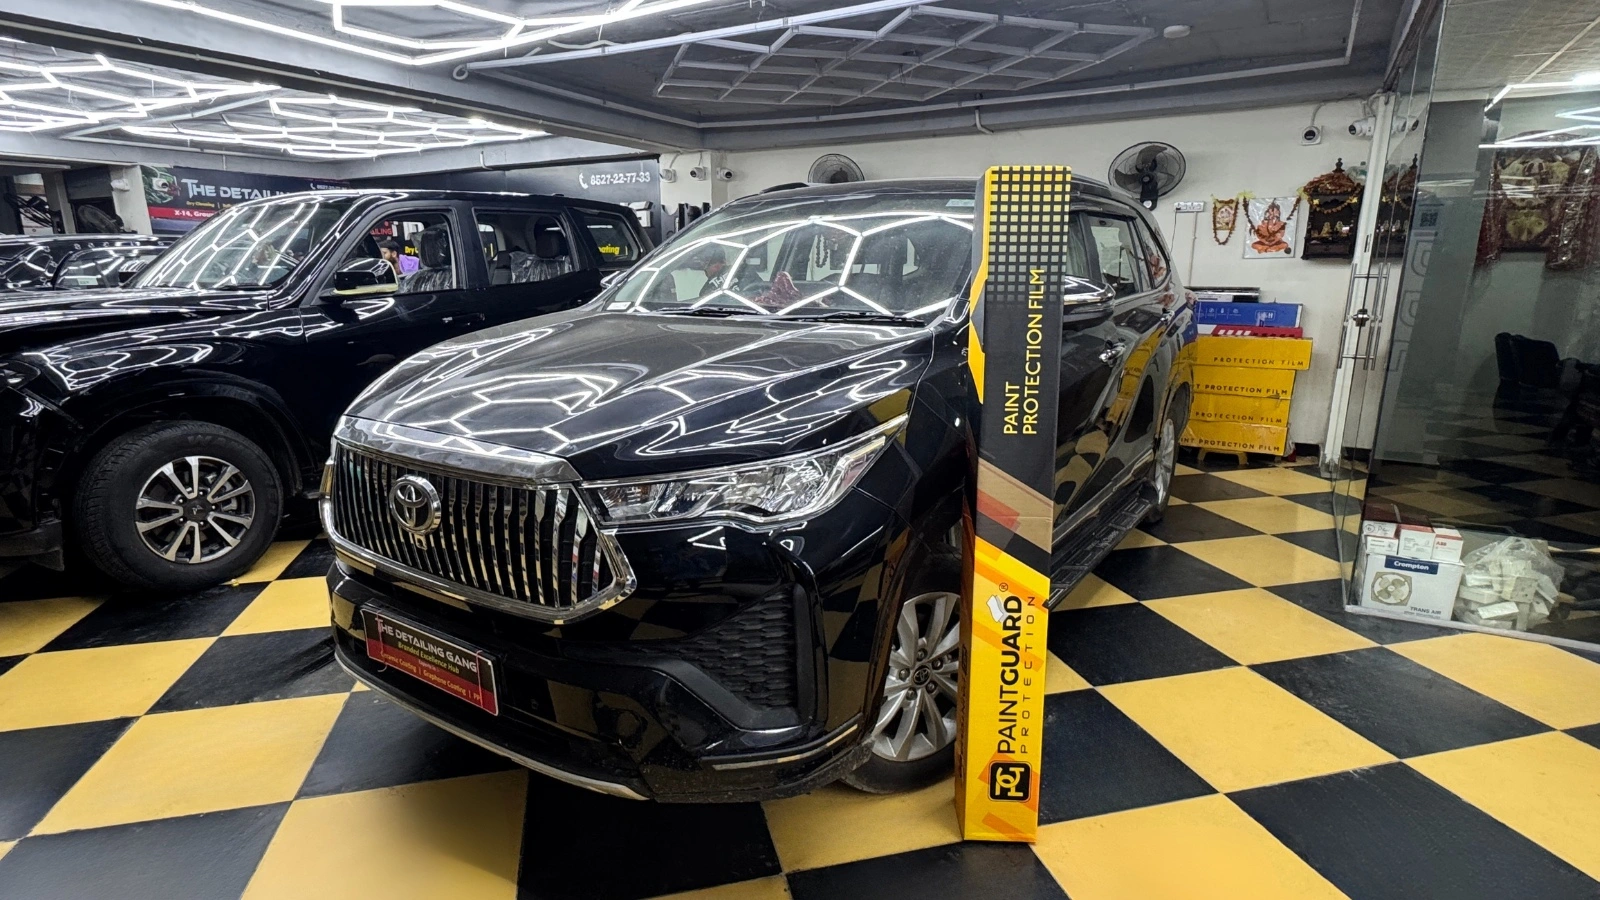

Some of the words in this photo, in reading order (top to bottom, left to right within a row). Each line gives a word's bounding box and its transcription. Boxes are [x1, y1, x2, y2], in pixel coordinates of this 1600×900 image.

[181, 178, 216, 198] THE
[590, 172, 650, 185] 8527-22-77-33
[1029, 268, 1045, 309] FILM
[1213, 357, 1275, 365] PROTECTION
[1022, 314, 1043, 435] PROTECTION
[1205, 384, 1262, 393] PROTECTION
[1003, 381, 1020, 434] PAINT
[1195, 411, 1254, 421] PROTECTION
[1198, 438, 1255, 449] PROTECTION
[1393, 560, 1430, 571] Crompton
[1410, 606, 1430, 614] TRANS
[375, 617, 394, 637] THE
[395, 629, 445, 658] DETAILING
[446, 651, 477, 673] GANG
[398, 641, 420, 656] Branded
[420, 651, 447, 669] Excellence
[447, 664, 460, 674] Hub
[399, 658, 417, 673] Coating
[423, 669, 447, 686] Graphene
[447, 680, 466, 696] Coating
[997, 595, 1024, 754] PAINTGUARD
[1020, 595, 1035, 754] PROTECTION
